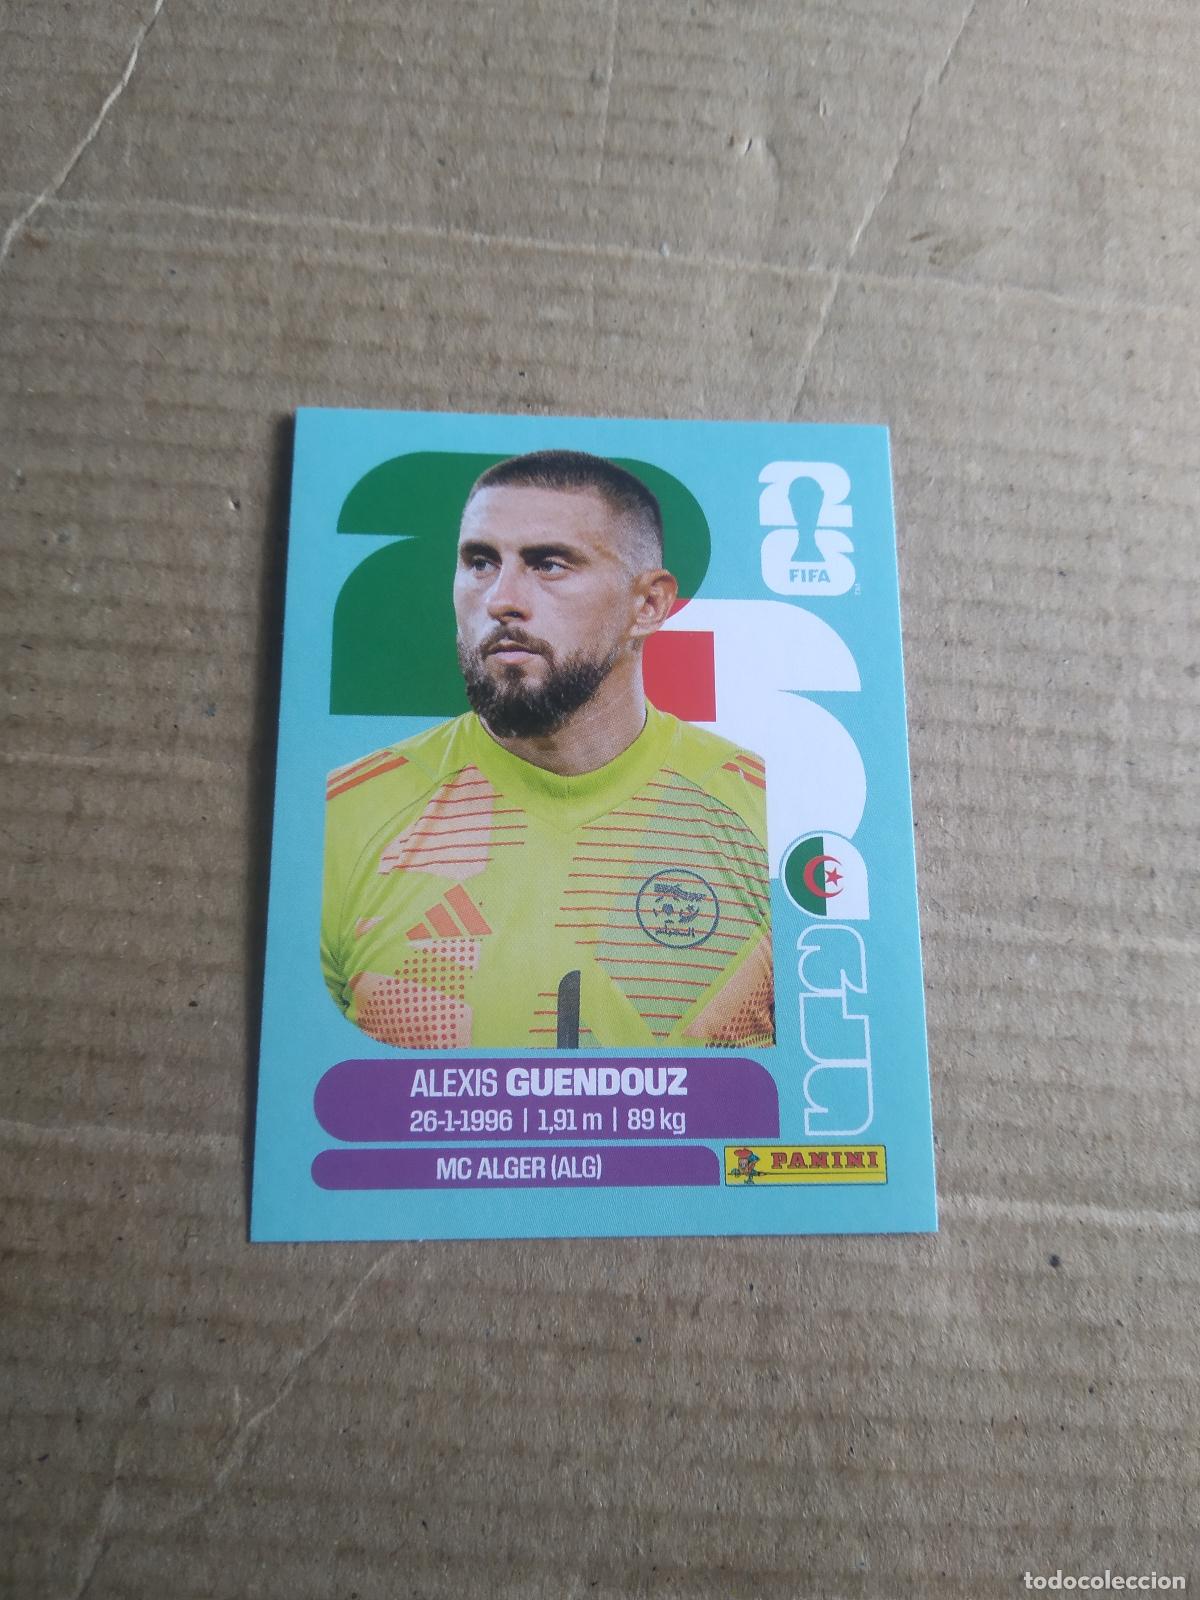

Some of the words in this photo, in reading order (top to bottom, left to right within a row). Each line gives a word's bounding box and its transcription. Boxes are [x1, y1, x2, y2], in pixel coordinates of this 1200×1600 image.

[789, 568, 830, 583] FIFA
[409, 1067, 498, 1098] ALEXIS
[505, 1066, 688, 1097] GUENDOUZ
[409, 1109, 513, 1132] 26-1-1996
[538, 1108, 578, 1135] 1,91
[582, 1112, 603, 1131] m
[627, 1107, 655, 1130] 89
[659, 1107, 686, 1135] kg
[436, 1157, 472, 1180] MC
[476, 1156, 546, 1180] ALGER
[551, 1153, 602, 1181] (ALG)
[771, 1151, 879, 1169] PANINI
